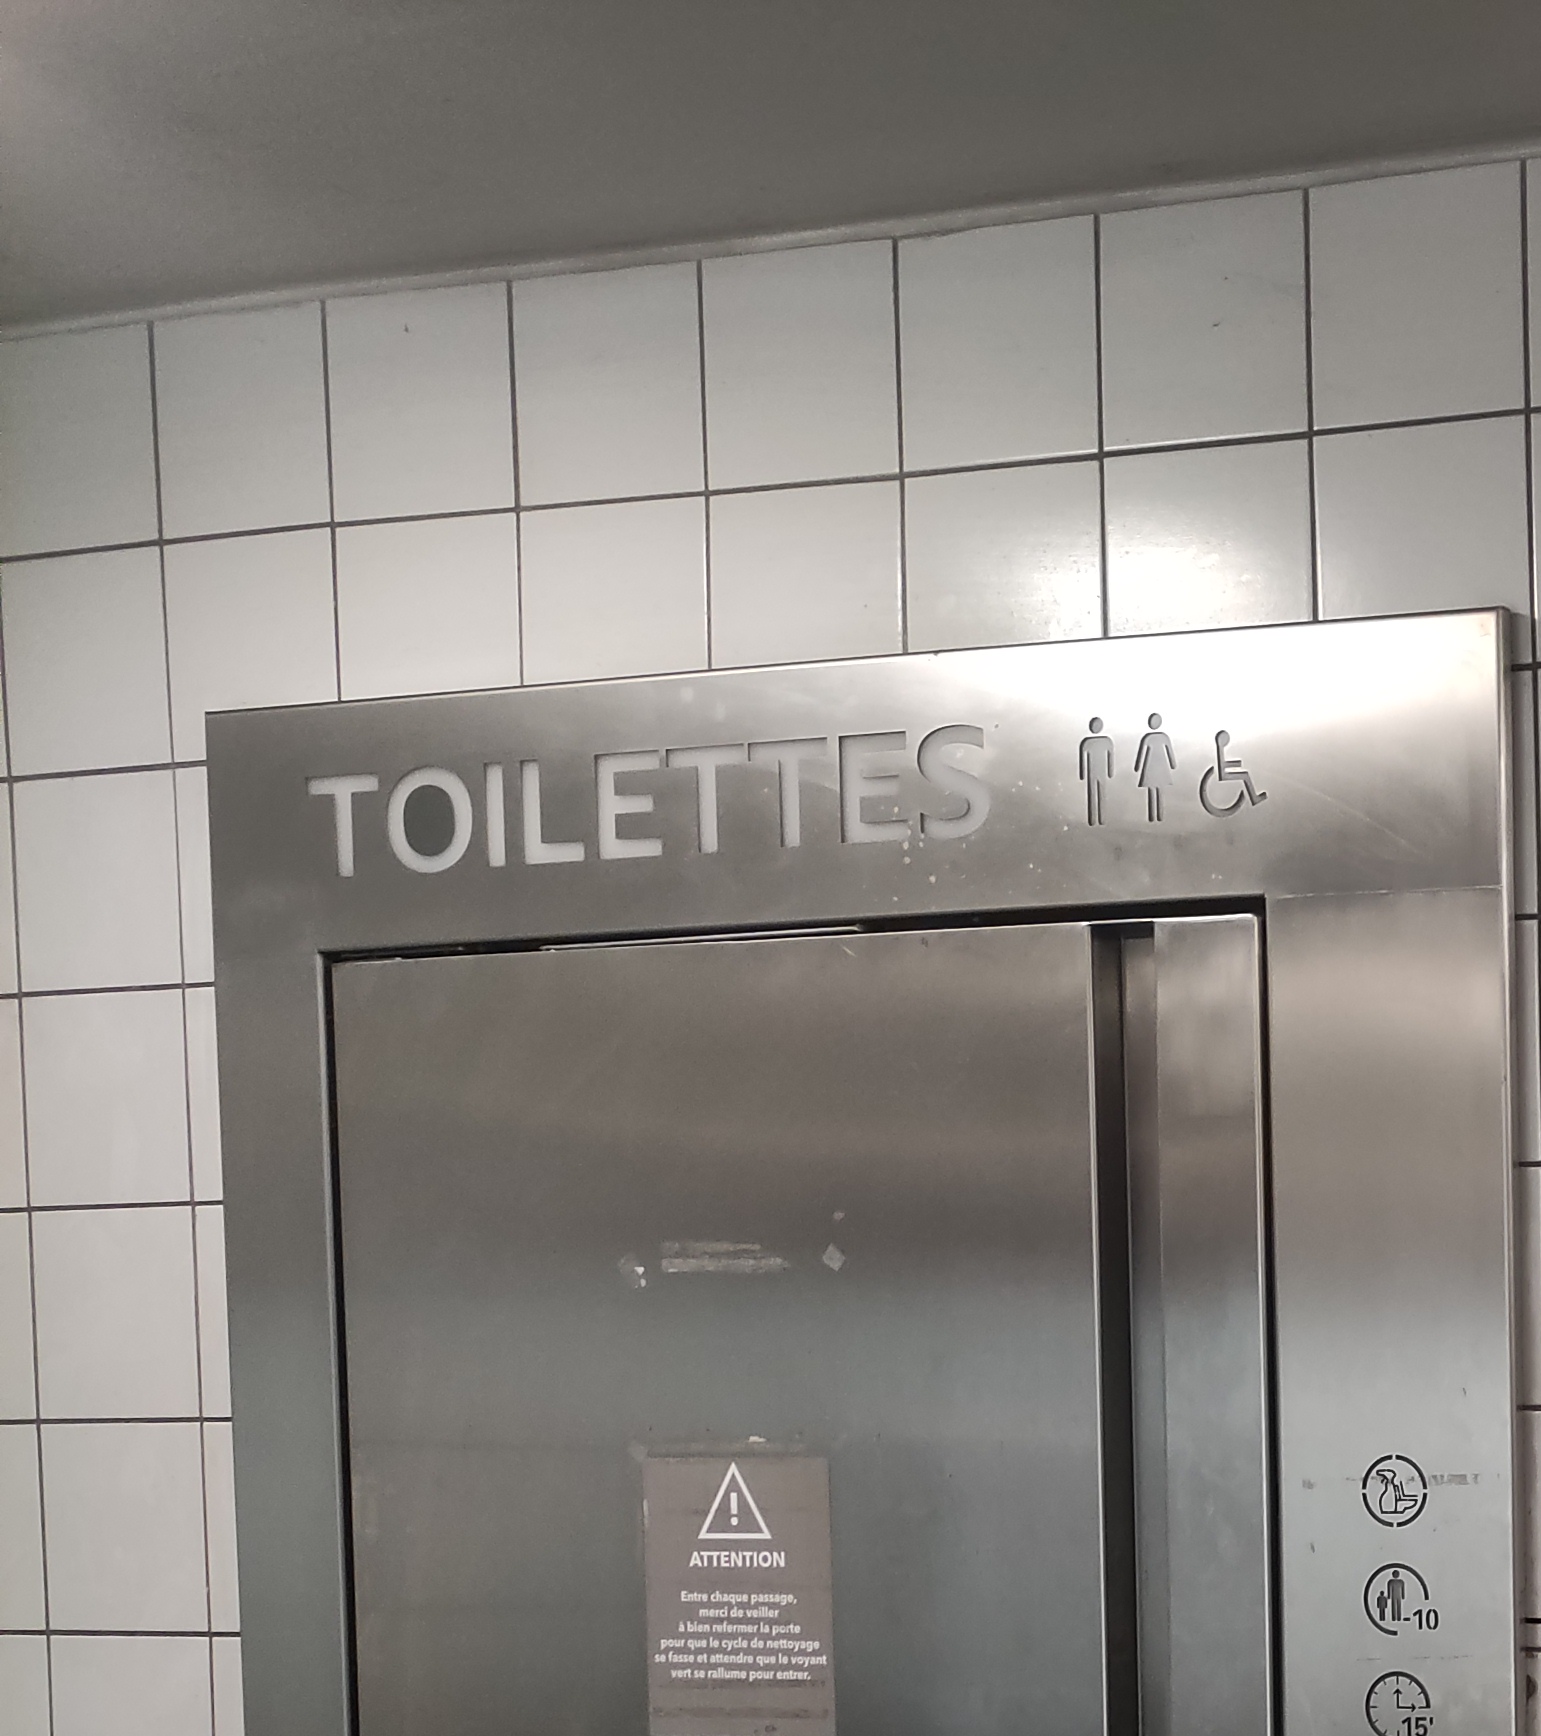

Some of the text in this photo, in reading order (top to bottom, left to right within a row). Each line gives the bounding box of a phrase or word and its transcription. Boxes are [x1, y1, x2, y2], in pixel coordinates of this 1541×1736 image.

[306, 724, 994, 877] TOILETTES
[689, 1551, 785, 1567] ATTENTION
[681, 1591, 708, 1602] Entre
[710, 1591, 748, 1604] chaque
[699, 1606, 779, 1617] merci de veiller
[1402, 1608, 1439, 1631] -10
[679, 1622, 801, 1636] à bien refermer la porte
[661, 1637, 820, 1651] pour que le cycle de nettoyage
[654, 1651, 827, 1667] se fasse et attendre que le voyant
[671, 1669, 691, 1678] vert
[694, 1670, 705, 1678] se
[708, 1668, 747, 1679] rallume
[749, 1670, 774, 1681] pour
